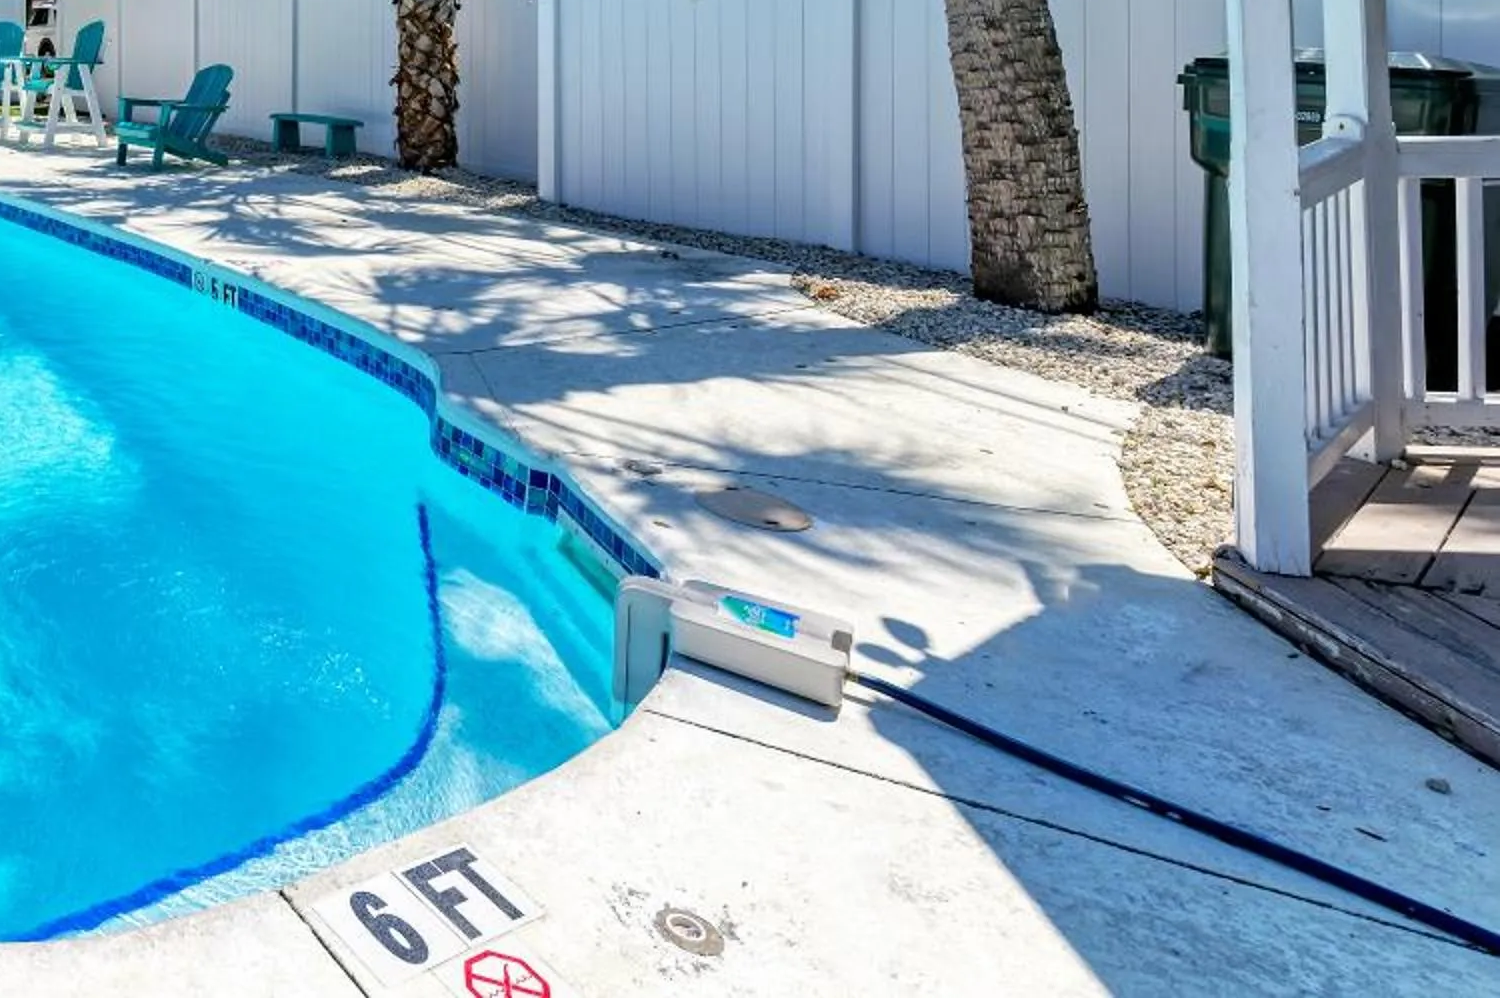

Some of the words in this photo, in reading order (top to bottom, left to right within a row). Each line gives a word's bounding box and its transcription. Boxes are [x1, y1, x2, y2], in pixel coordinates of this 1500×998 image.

[223, 283, 237, 309] FT
[349, 890, 429, 965] 6
[401, 846, 525, 941] FT
